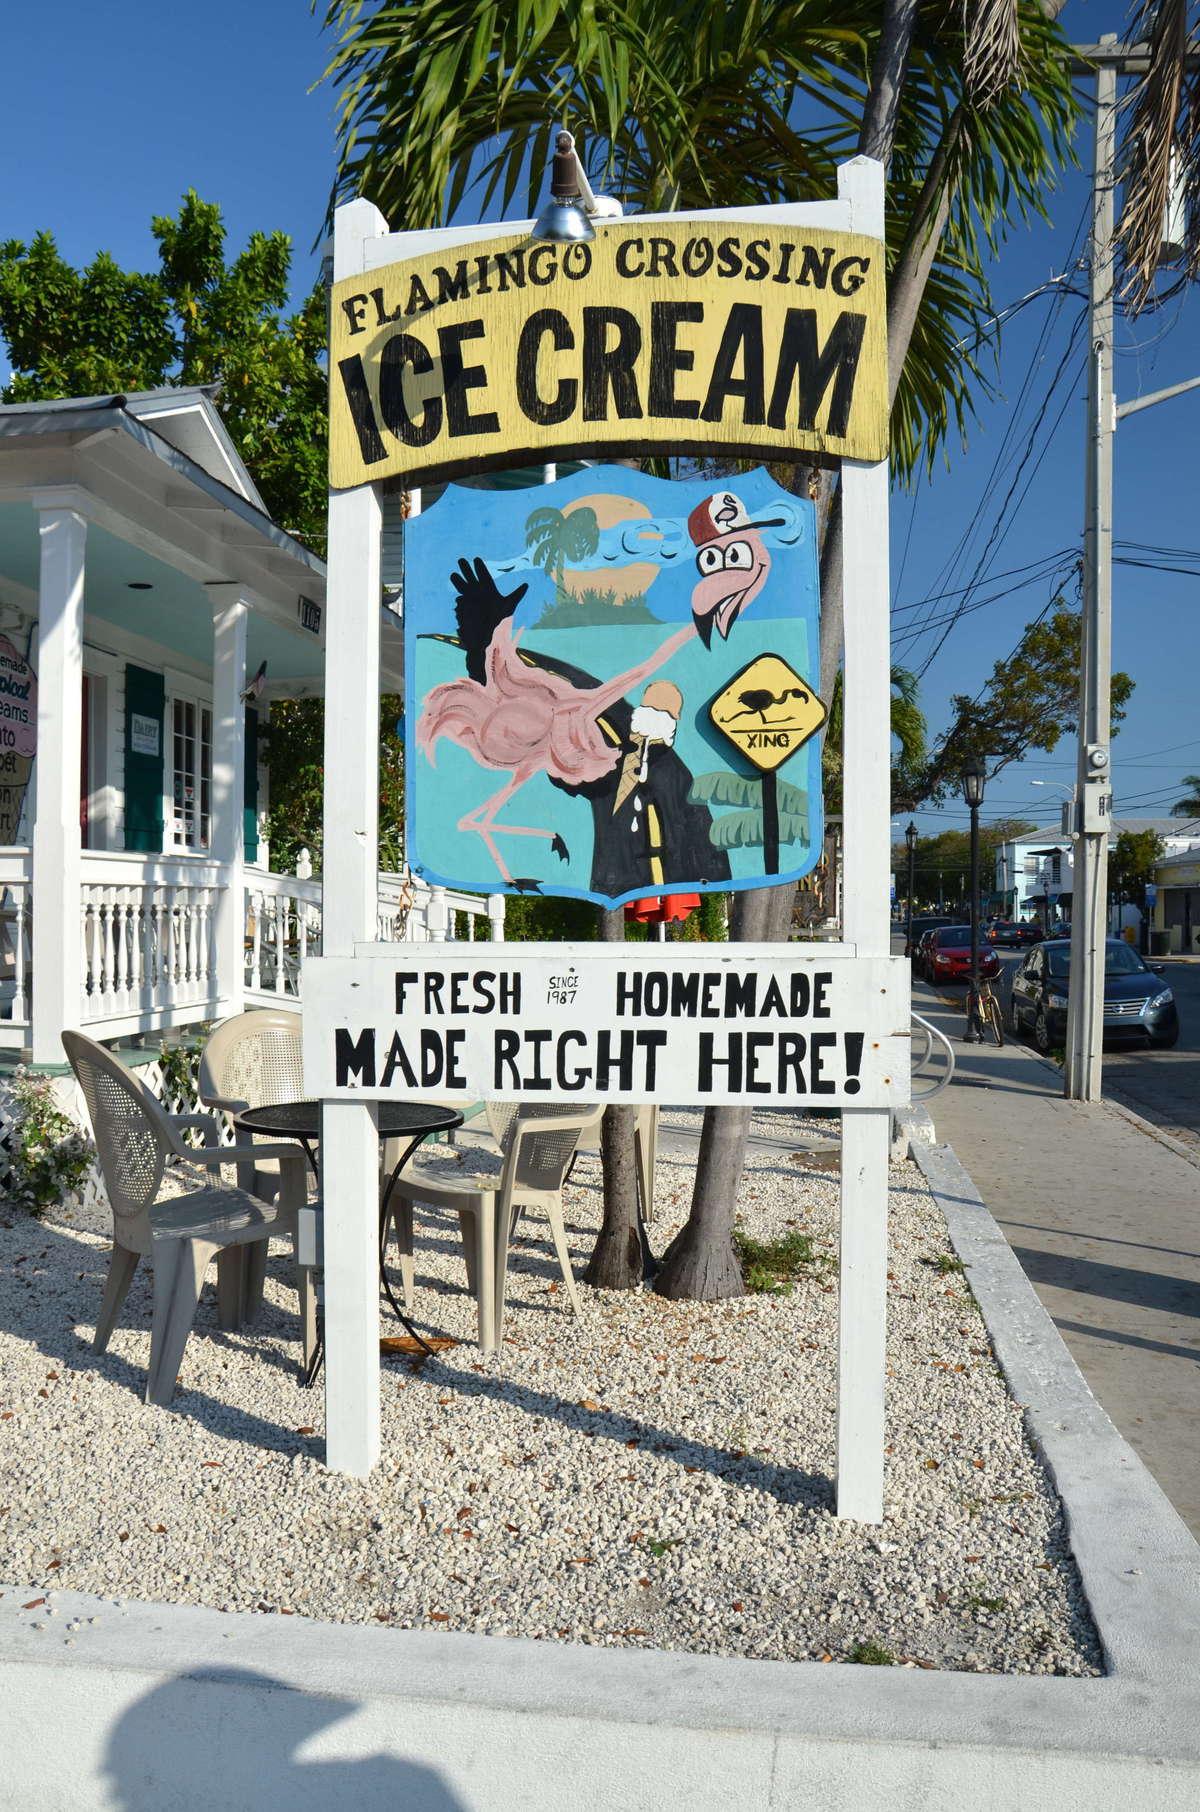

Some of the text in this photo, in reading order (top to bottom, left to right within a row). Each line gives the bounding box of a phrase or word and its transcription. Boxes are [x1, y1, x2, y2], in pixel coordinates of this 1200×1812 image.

[342, 237, 871, 335] FLAMINGO CROSSING
[338, 301, 867, 465] ICE CREAM
[747, 733, 790, 748] XING
[395, 971, 833, 1019] FRESH HOMEMADE
[547, 990, 577, 1004] 1987
[549, 976, 579, 989] SINCE
[335, 1028, 865, 1095] MADE RIGHT HERE!
